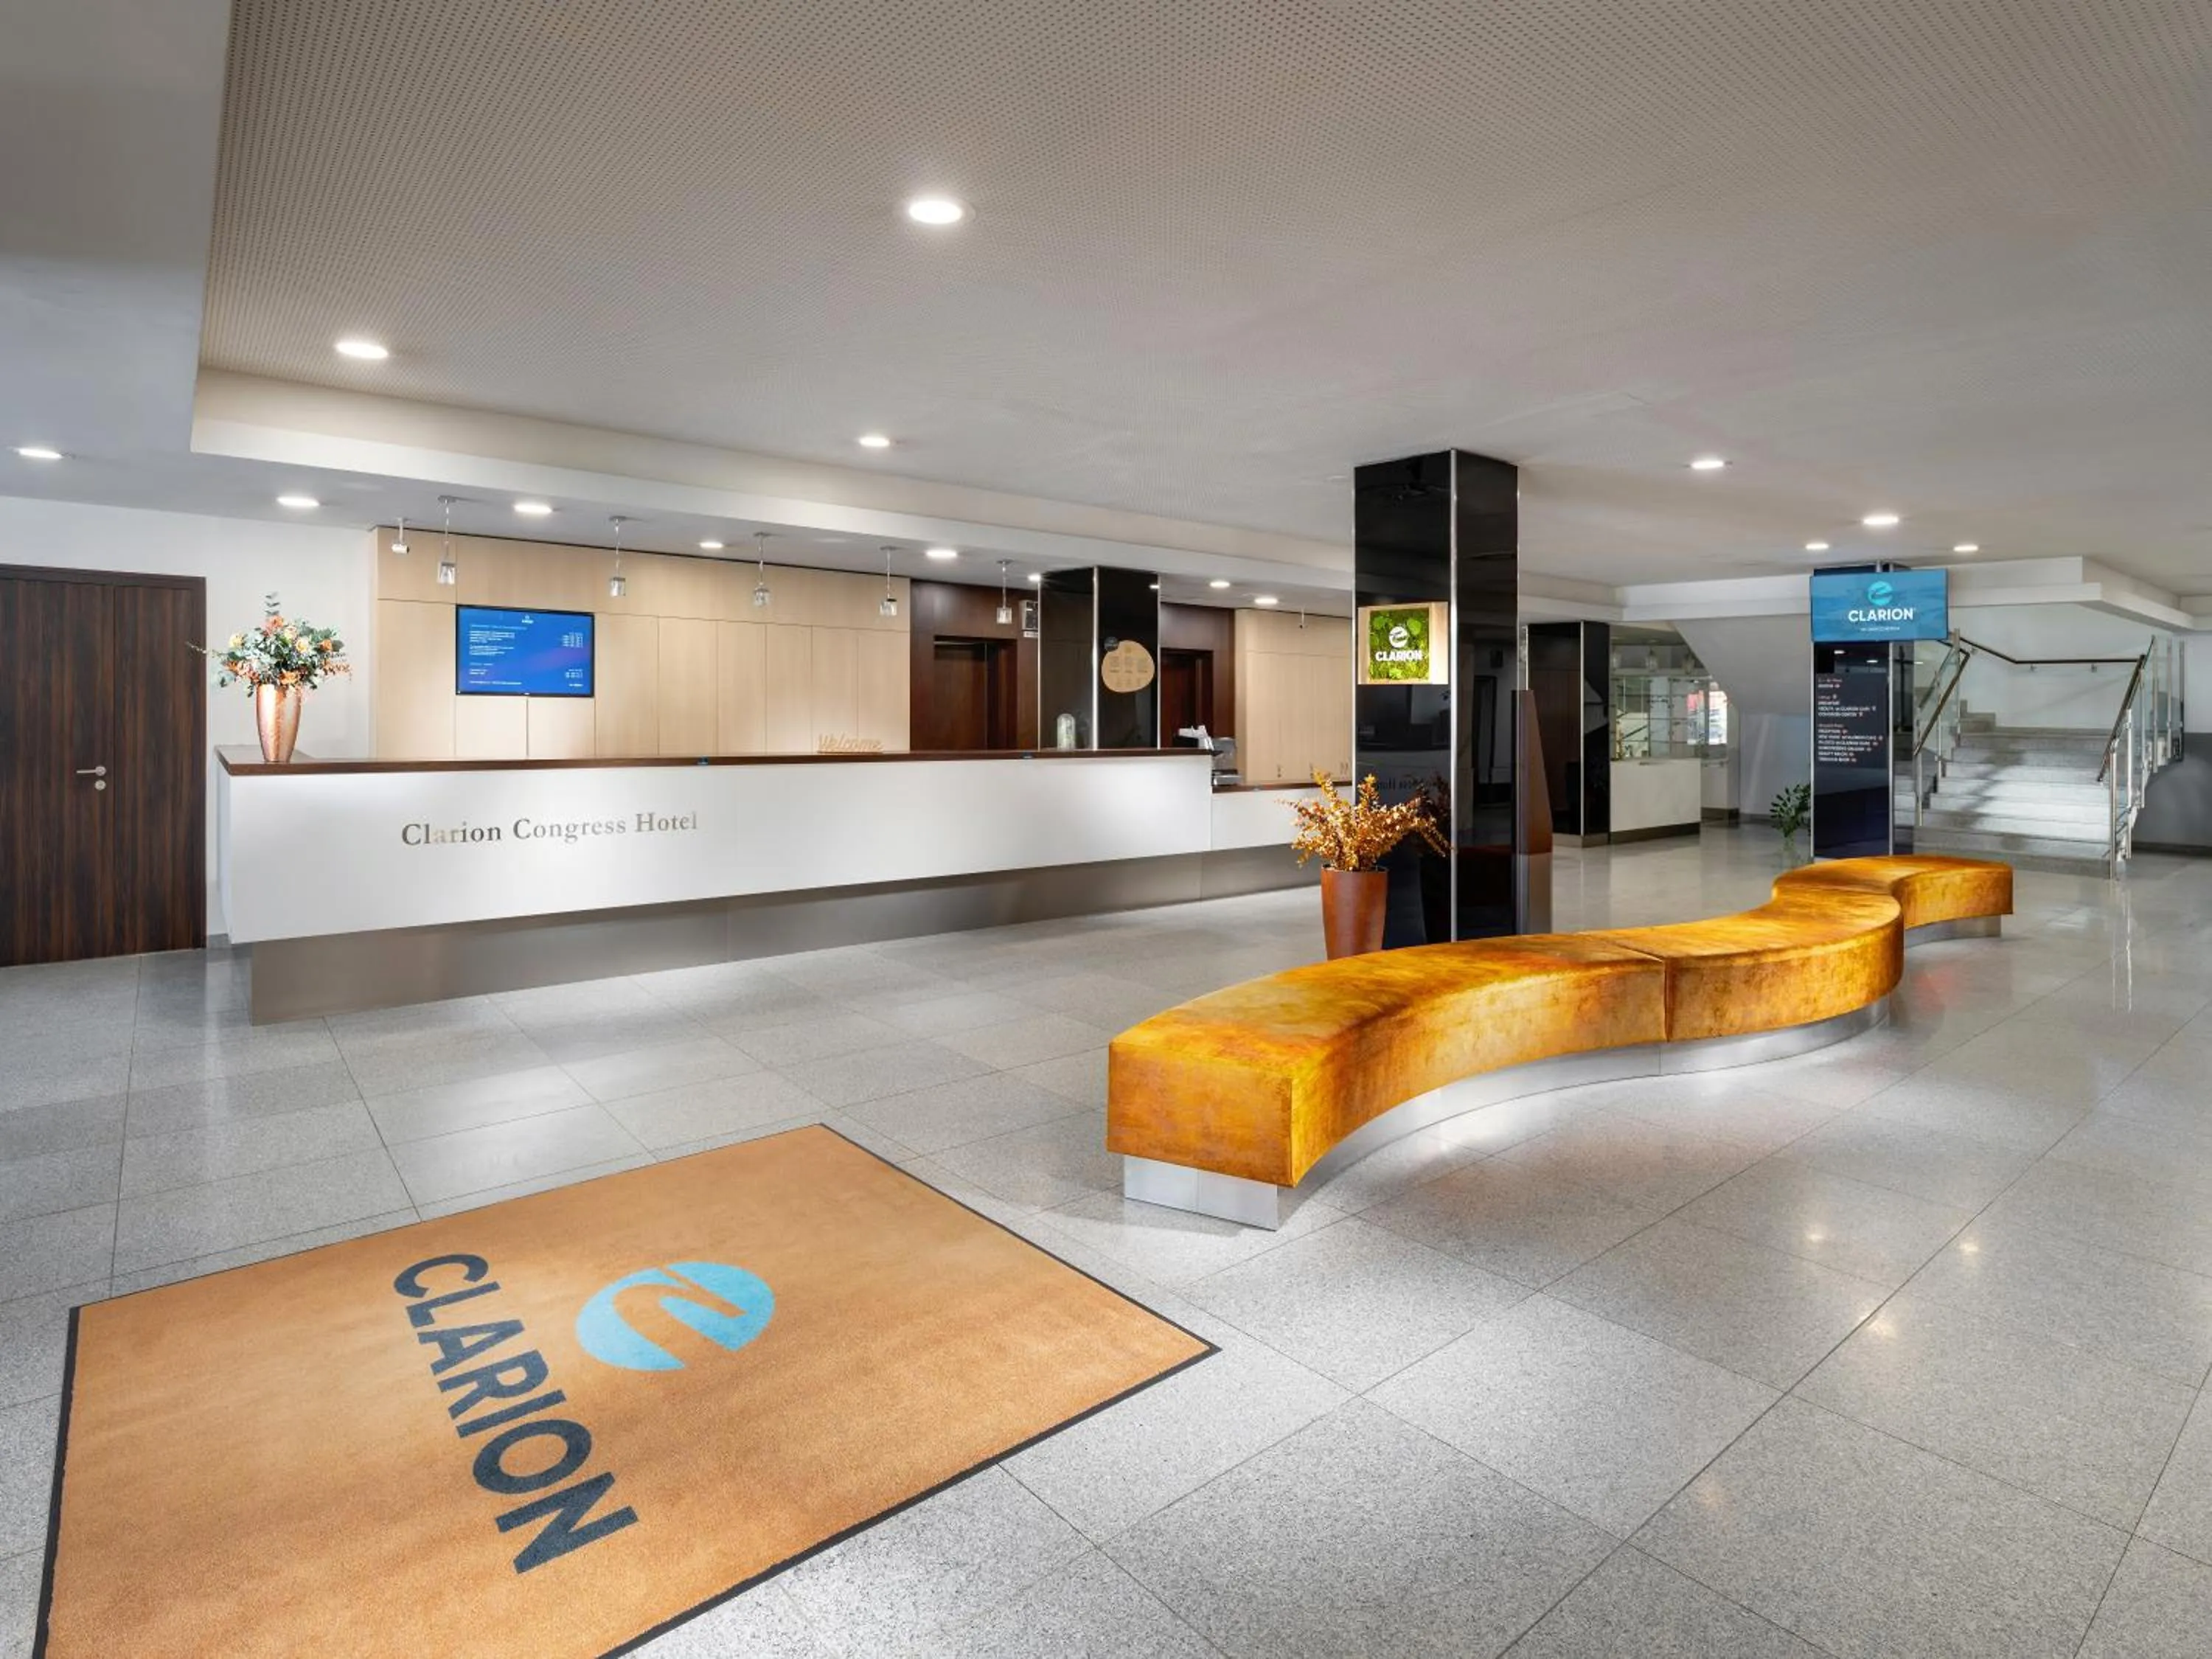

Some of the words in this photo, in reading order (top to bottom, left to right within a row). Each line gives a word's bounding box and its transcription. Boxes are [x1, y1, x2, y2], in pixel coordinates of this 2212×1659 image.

[1848, 607, 1913, 622] CLARION
[1375, 650, 1422, 661] CLARION
[401, 821, 501, 846] Clarion
[512, 818, 627, 843] Congress
[635, 812, 698, 833] Hotel
[393, 1253, 639, 1574] CLARION
